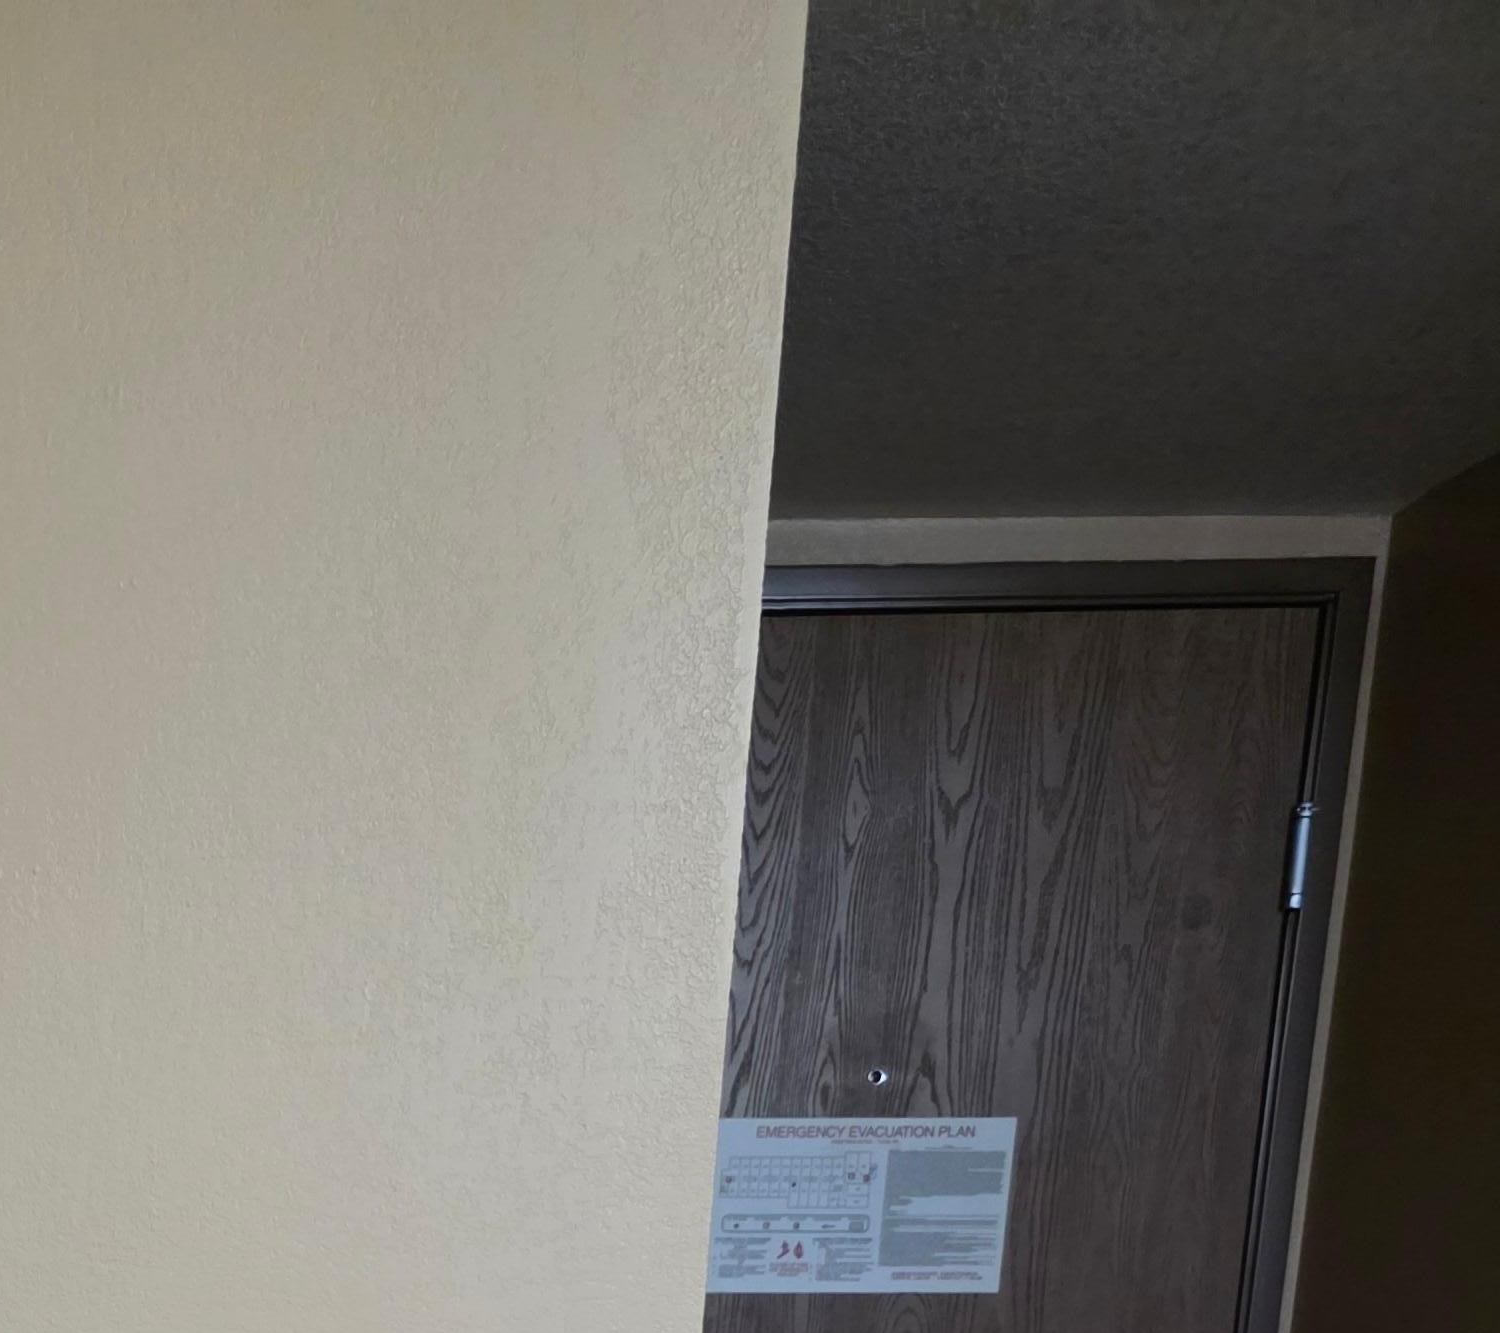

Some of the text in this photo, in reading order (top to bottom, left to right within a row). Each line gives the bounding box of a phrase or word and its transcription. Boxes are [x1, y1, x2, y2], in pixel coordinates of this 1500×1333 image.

[756, 1125, 976, 1139] EMERGENCY EVACUATION PLAN
